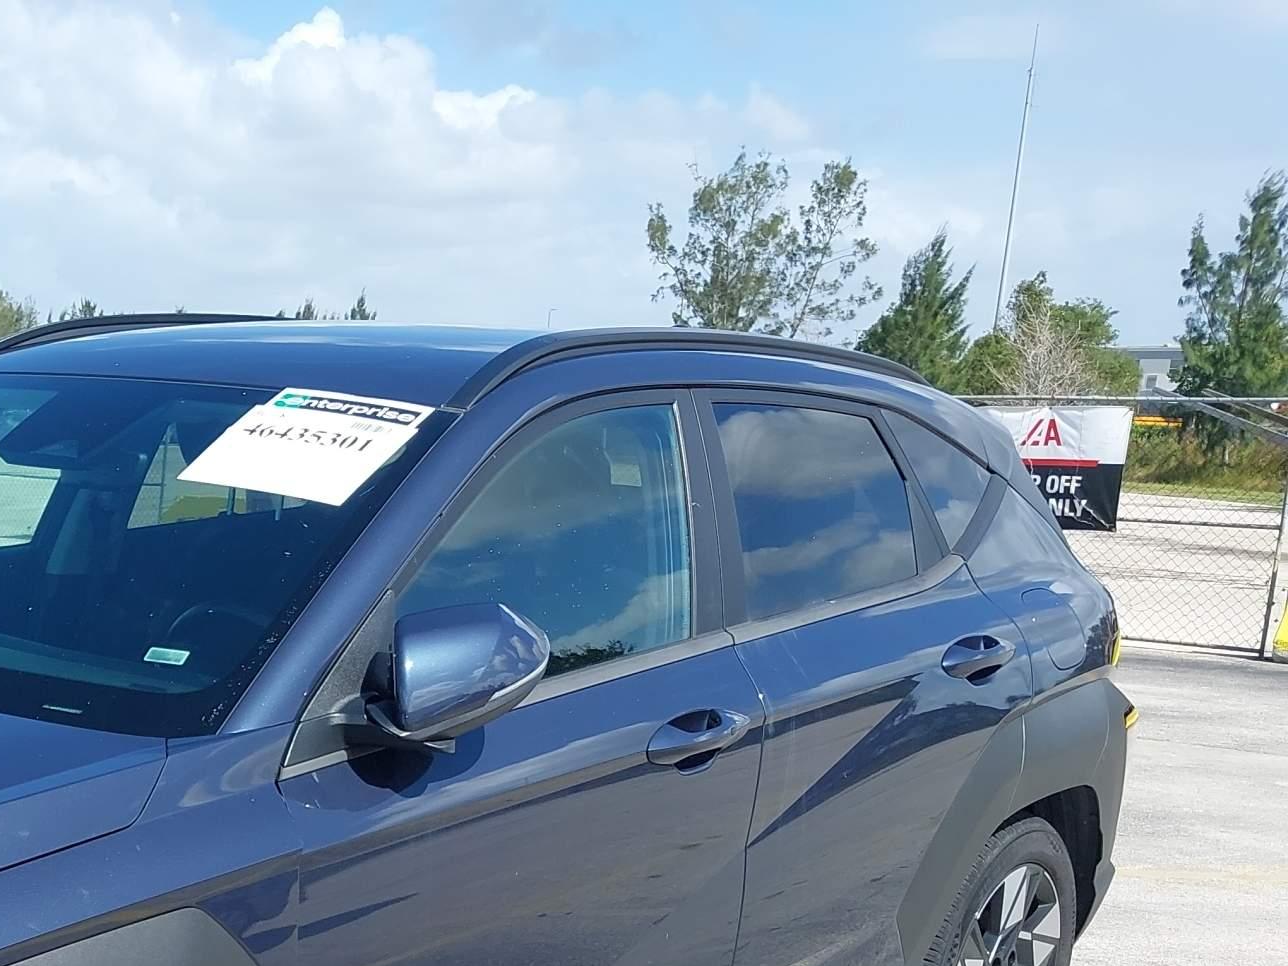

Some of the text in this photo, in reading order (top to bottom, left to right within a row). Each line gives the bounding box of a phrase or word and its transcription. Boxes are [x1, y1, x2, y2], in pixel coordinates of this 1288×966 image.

[274, 393, 416, 422] enterprise
[243, 423, 373, 452] 46435301
[1045, 474, 1083, 495] OFF
[1048, 498, 1088, 517] NLY
